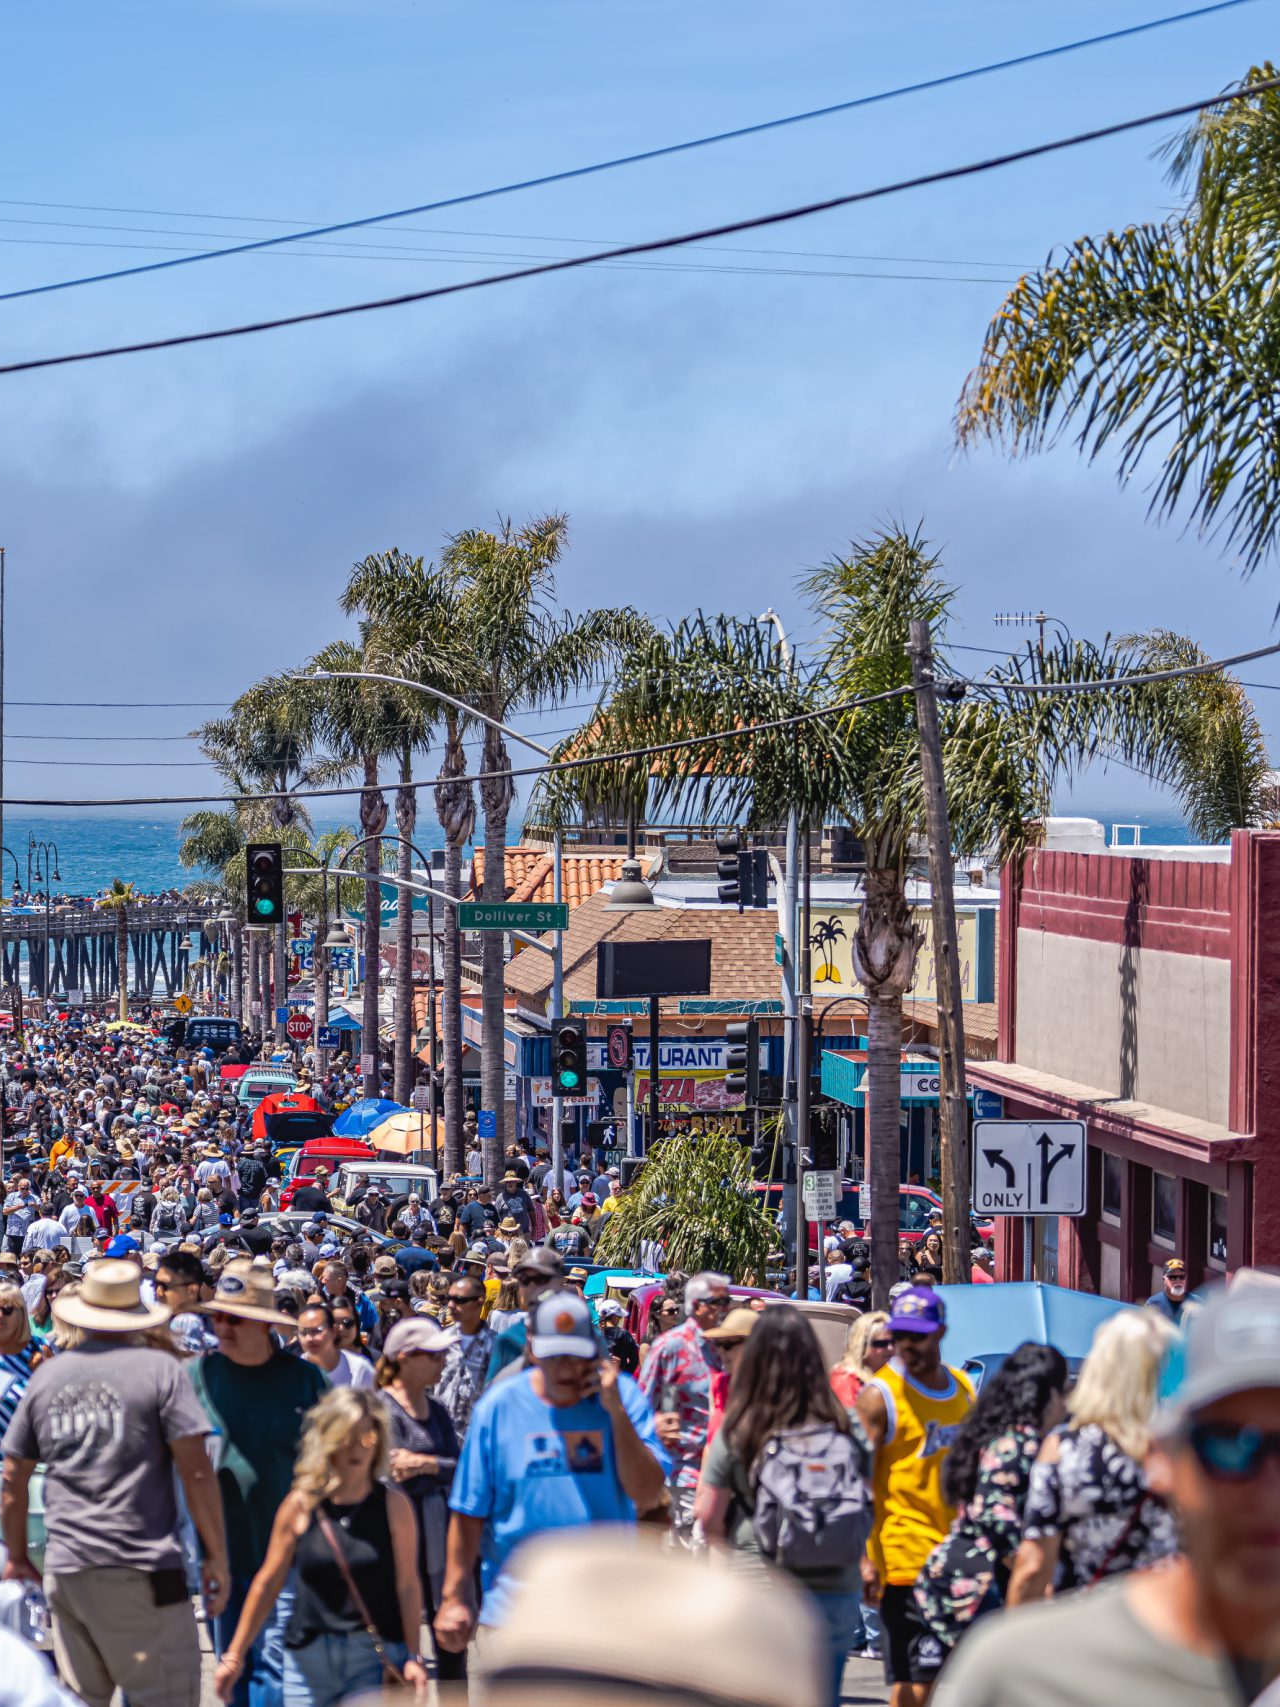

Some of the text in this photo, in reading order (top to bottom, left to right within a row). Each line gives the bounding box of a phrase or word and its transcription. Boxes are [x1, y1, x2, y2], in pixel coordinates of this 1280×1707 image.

[474, 910, 552, 922] Dolliver St
[289, 1022, 312, 1033] STOP
[536, 1096, 554, 1104] Ice
[691, 1117, 747, 1135] BOWL
[806, 1176, 814, 1190] 3
[982, 1193, 1023, 1207] ONLY
